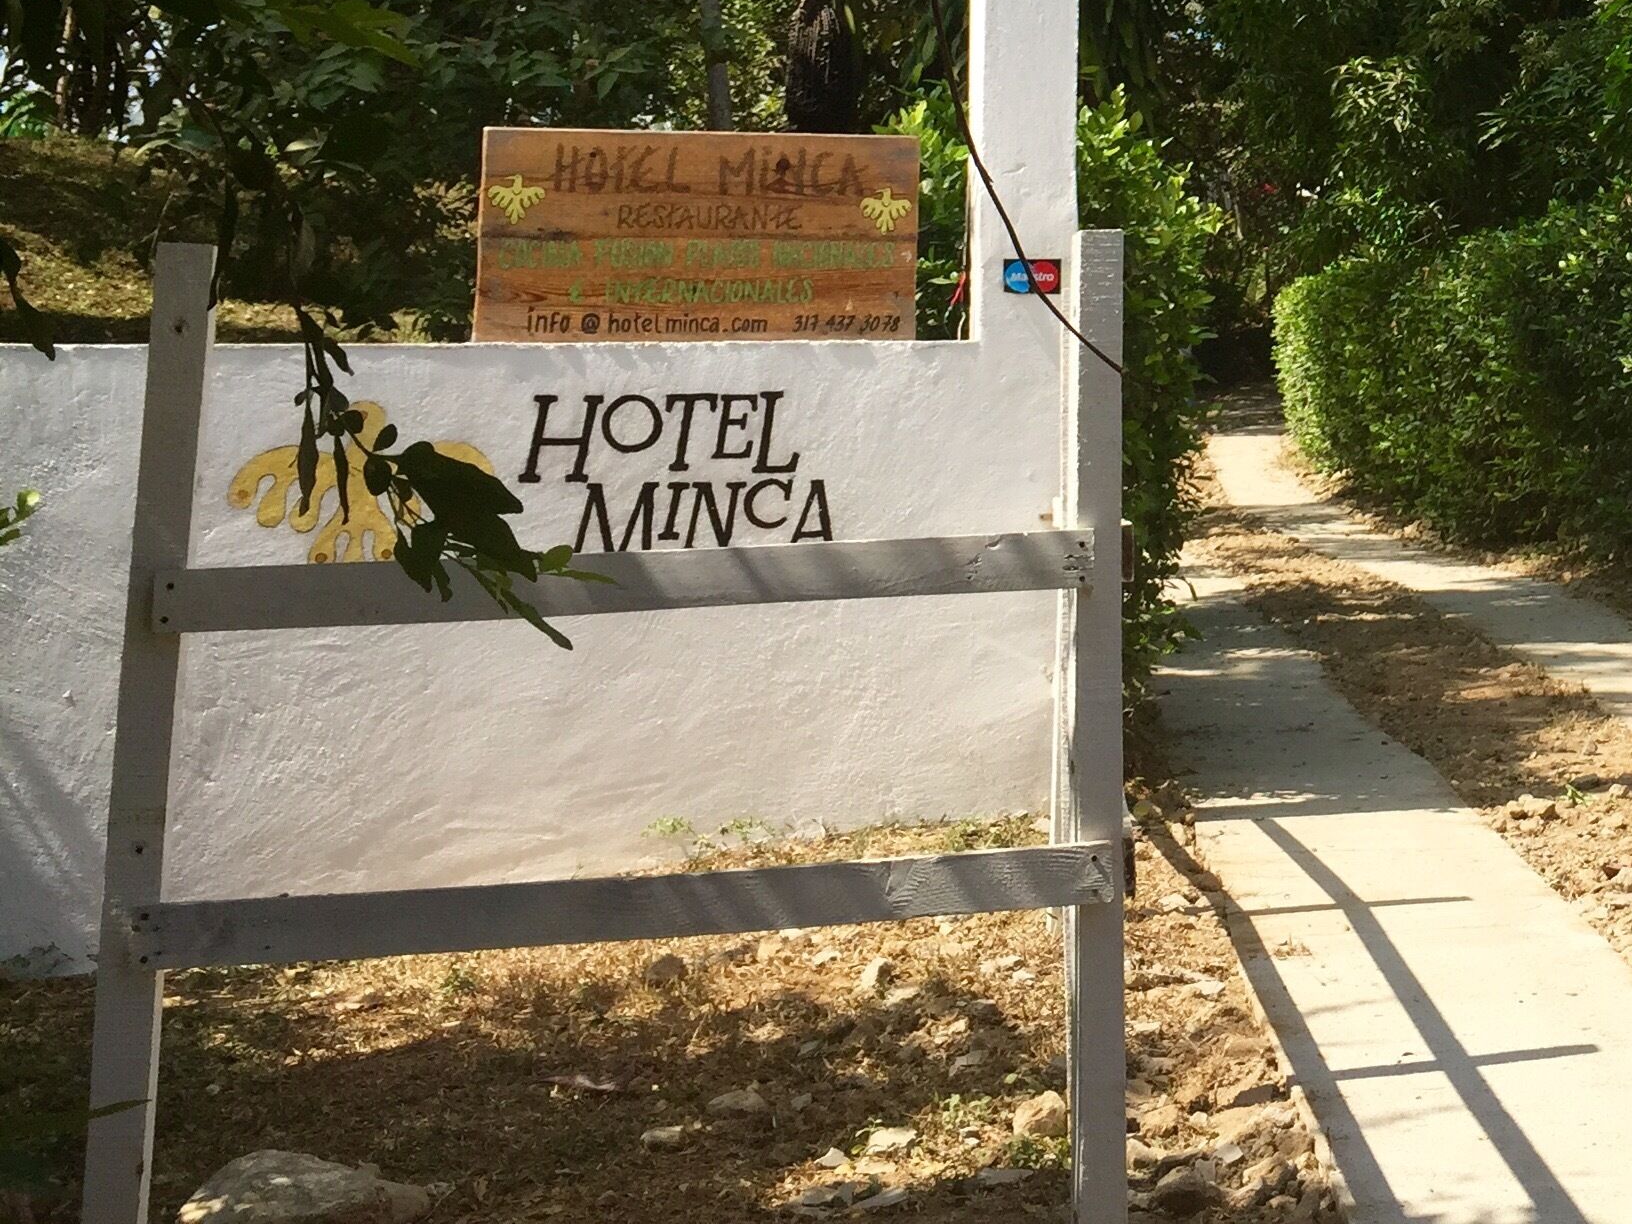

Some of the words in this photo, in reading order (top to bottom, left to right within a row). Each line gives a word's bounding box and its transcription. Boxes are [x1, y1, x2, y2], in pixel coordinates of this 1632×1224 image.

[553, 142, 691, 194] HOTEL
[616, 203, 802, 230] RESTAURANTE
[519, 391, 801, 483] HOTEL
[574, 478, 834, 552] MINCA
